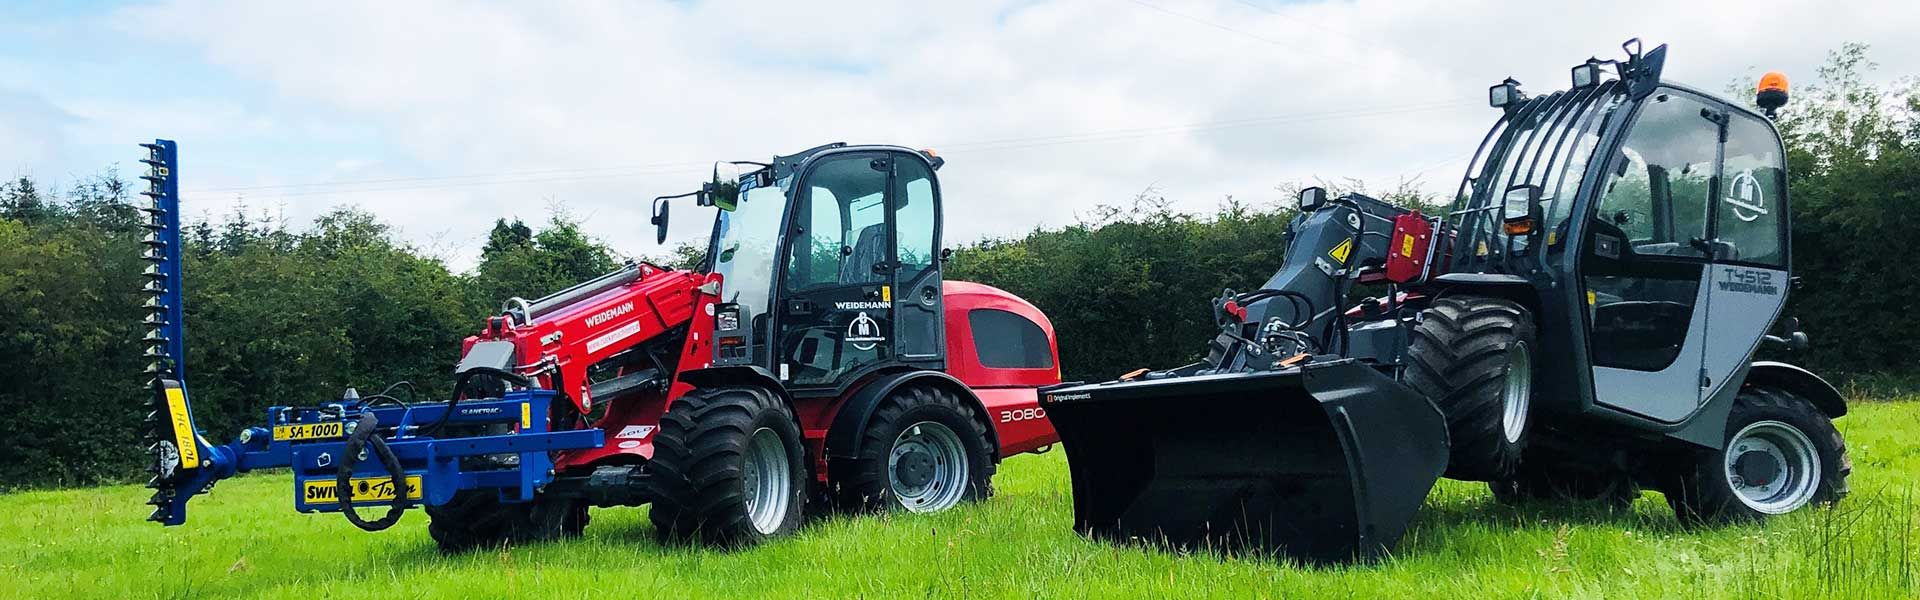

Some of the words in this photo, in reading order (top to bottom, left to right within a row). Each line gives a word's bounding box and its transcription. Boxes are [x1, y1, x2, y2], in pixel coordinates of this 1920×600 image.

[1725, 268, 1771, 285] T4512
[835, 301, 891, 309] WEIDEMANN
[585, 301, 634, 328] WEIDEMANN
[1001, 407, 1046, 423] 3080
[289, 424, 339, 438] SA-1000
[307, 484, 355, 499] SWIVL
